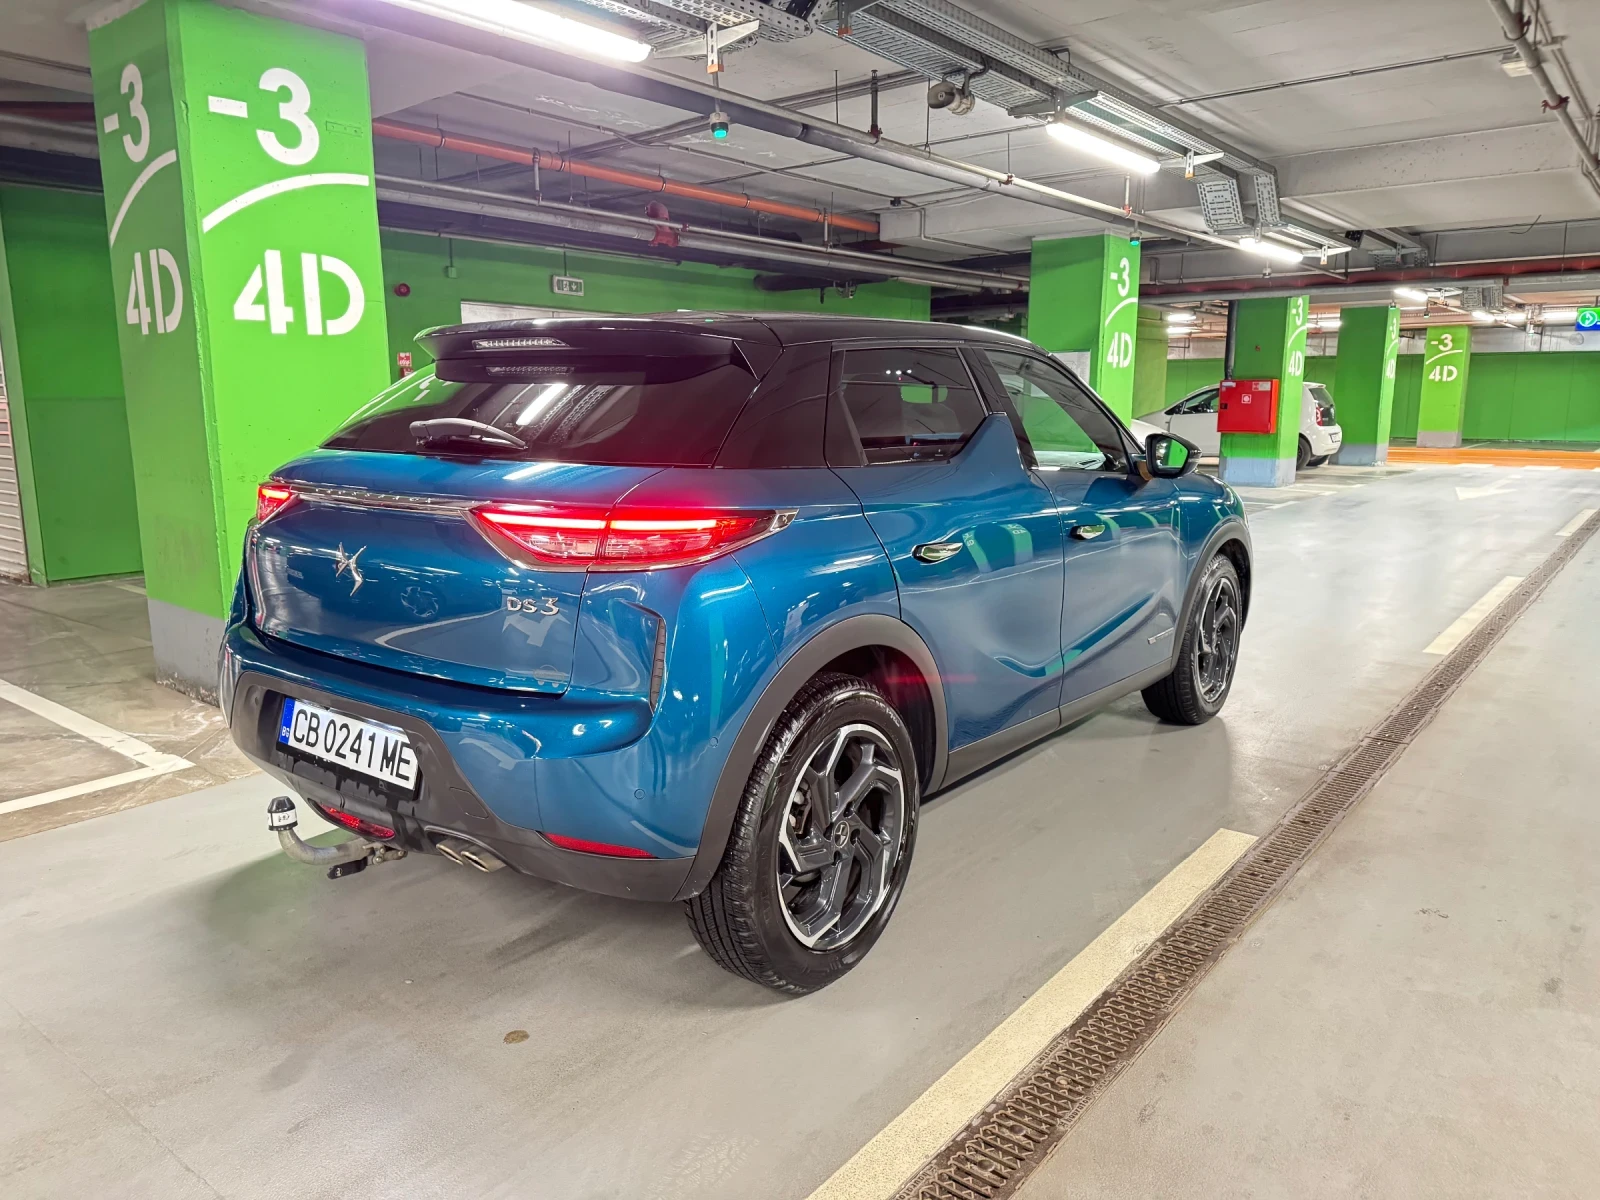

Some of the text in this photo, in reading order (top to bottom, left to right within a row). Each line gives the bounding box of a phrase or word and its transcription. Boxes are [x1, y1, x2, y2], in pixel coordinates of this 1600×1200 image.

[103, 63, 150, 163] -3
[207, 67, 320, 166] -3
[126, 248, 183, 335] 4D
[233, 249, 365, 335] 4D
[1110, 257, 1130, 297] -3
[1290, 297, 1303, 326] -3
[1107, 331, 1133, 368] 4D
[1430, 333, 1453, 351] -3
[1288, 350, 1303, 376] 4D
[1428, 365, 1458, 382] 4D
[507, 596, 560, 616] DS 3
[281, 726, 290, 737] BG
[293, 708, 415, 781] CB 0241 ME
